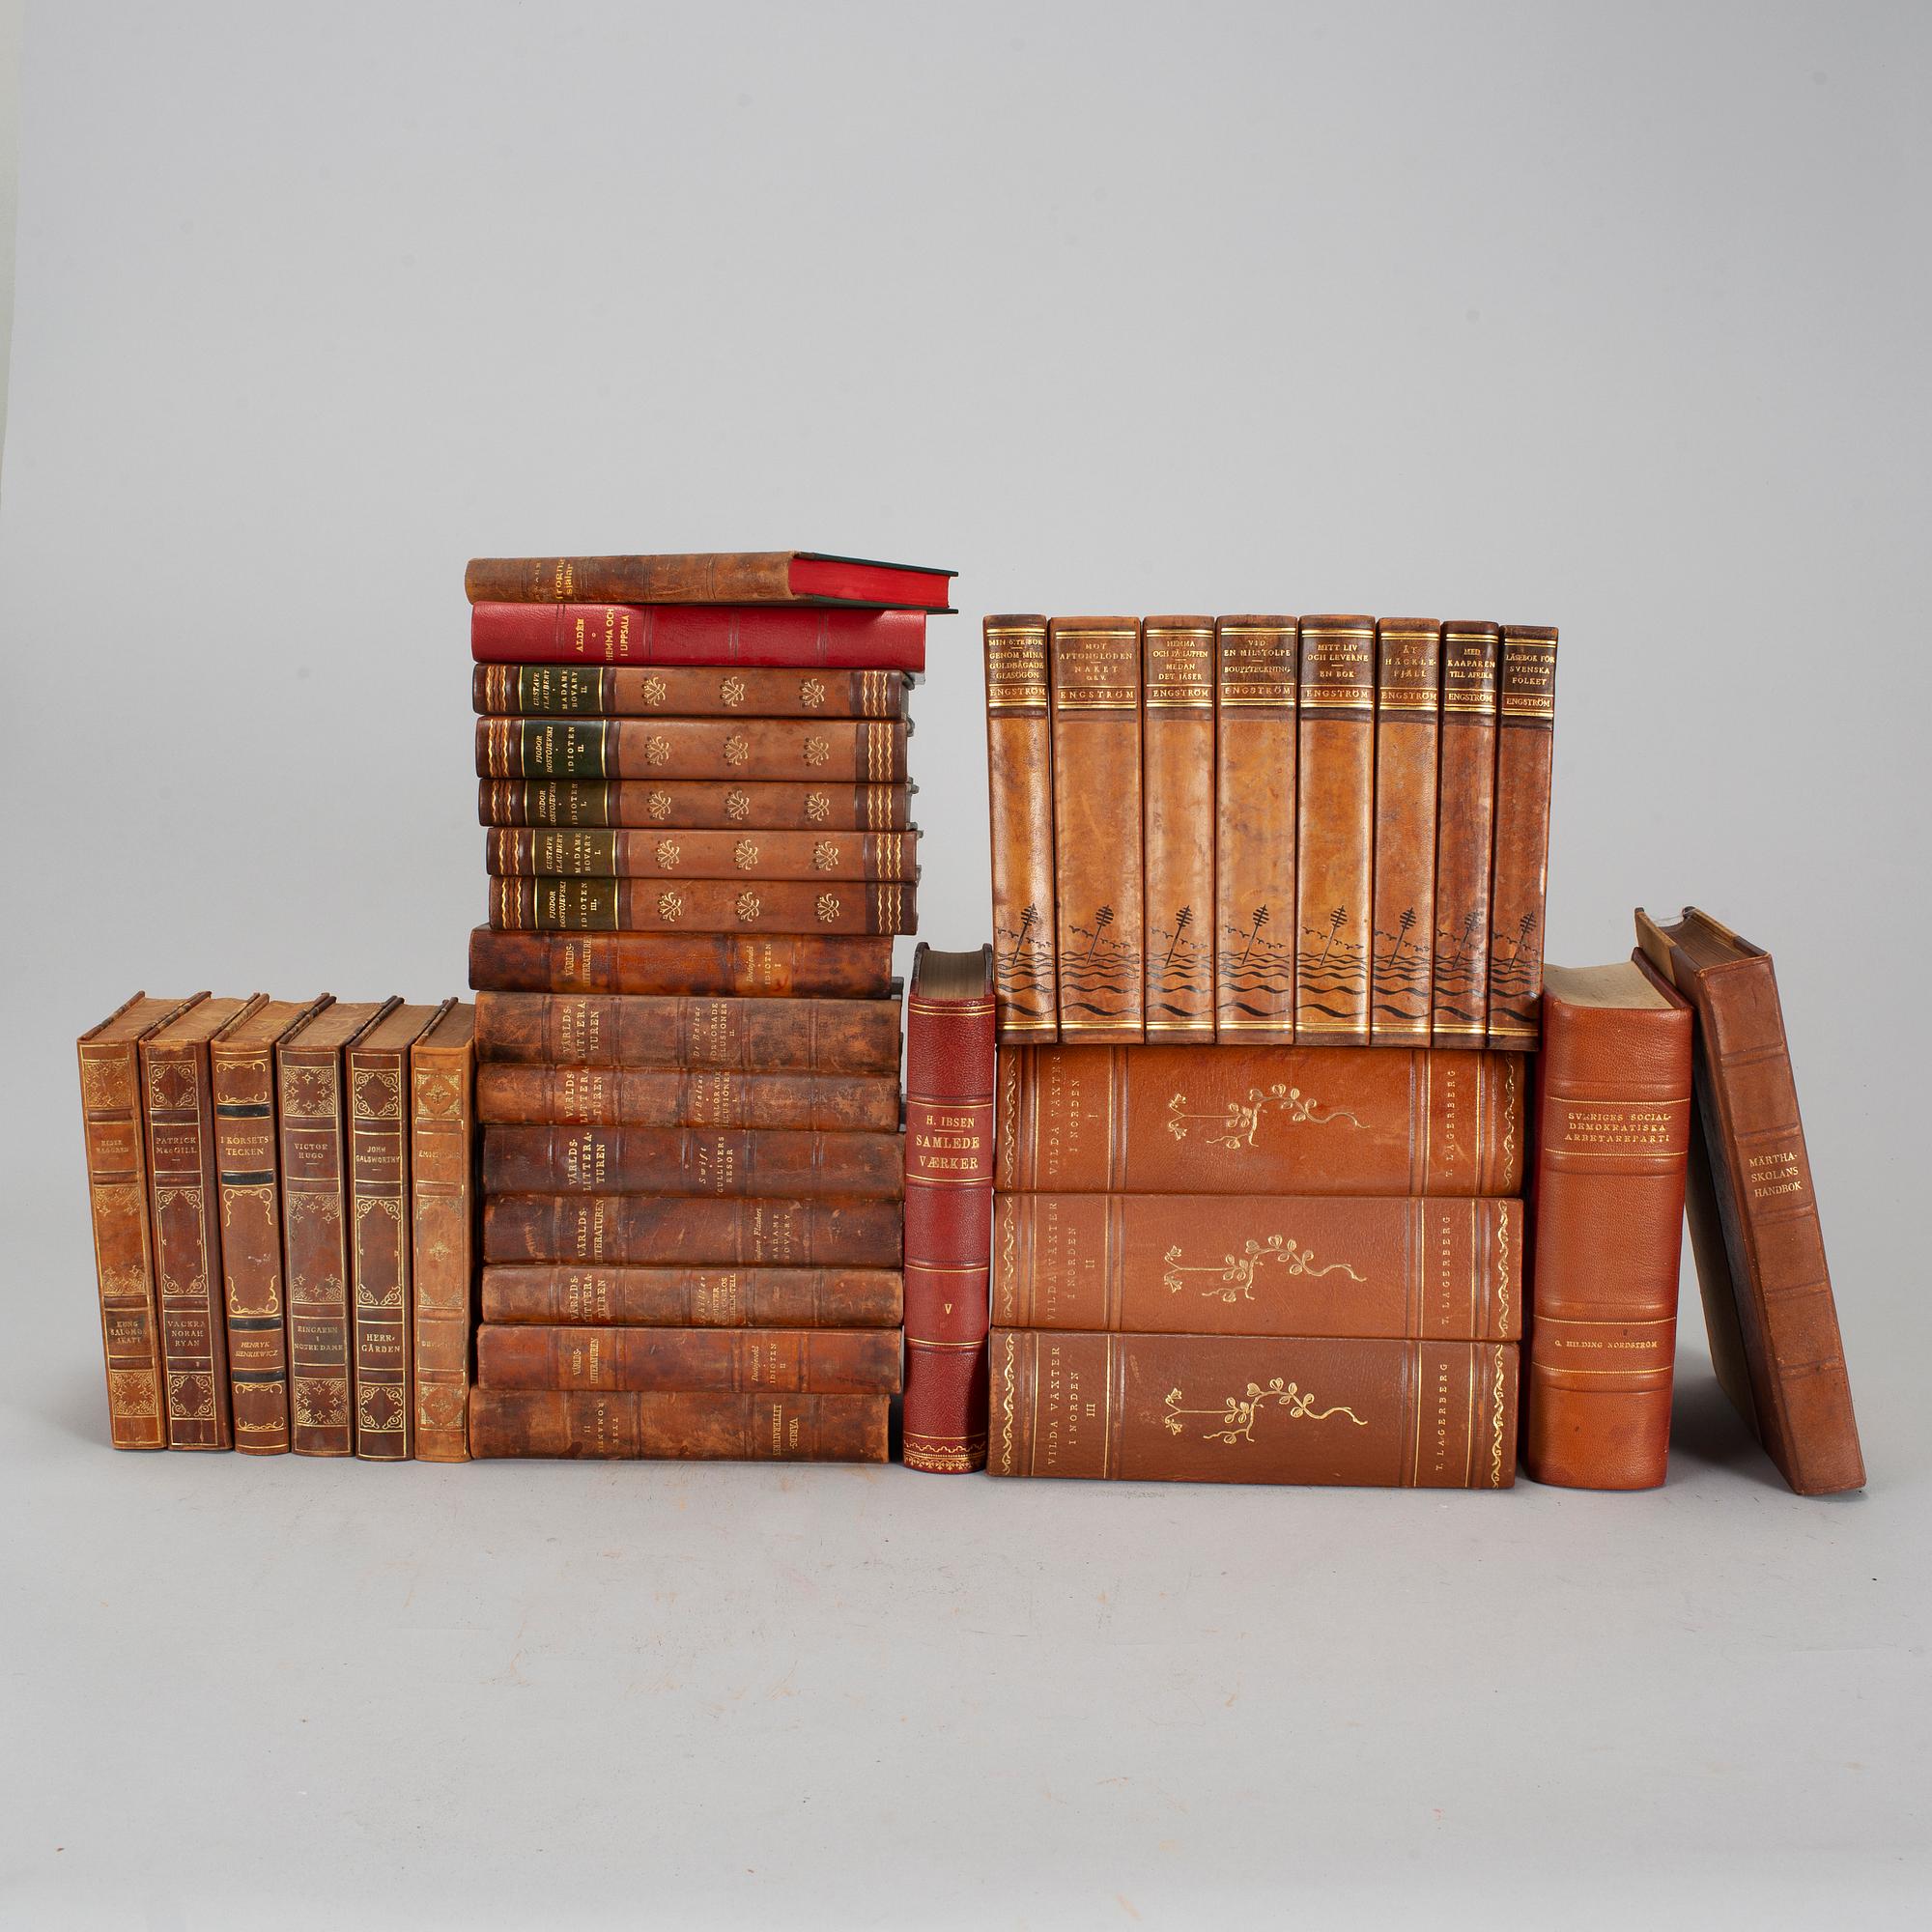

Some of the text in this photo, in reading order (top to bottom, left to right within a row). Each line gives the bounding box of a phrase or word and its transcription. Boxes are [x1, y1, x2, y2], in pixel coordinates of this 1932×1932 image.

[620, 614, 629, 650] UPPSALA
[1510, 666, 1549, 674] SVENSKA
[989, 687, 1045, 696] ENGSTRÖM
[1060, 690, 1134, 698] ENGSTRÖM
[1153, 689, 1208, 697] ENGSTRÖM
[1225, 686, 1291, 695] ENGSTRÖM
[1306, 690, 1368, 698] ENGSTRÖM
[1381, 692, 1436, 700] ENGSTRÖM
[1449, 694, 1492, 702] ENGSTRÖM
[1507, 697, 1549, 707] ENGSTRÖM
[590, 1010, 599, 1050] TUREN
[593, 1076, 602, 1115] TUREN
[1070, 1080, 1080, 1138] NORDEN
[1446, 1070, 1455, 1161] LAGERBERG
[926, 1116, 975, 1128] H. IBSEN
[1569, 1122, 1665, 1131] DEMOKRATISKA
[917, 1135, 980, 1149] SAMLEDE
[1565, 1134, 1669, 1143] ARBETAREPARTI
[225, 1148, 264, 1156] TECKEN
[1050, 1127, 1060, 1175] VILDA
[355, 1154, 400, 1163] GALSWORTHY
[596, 1144, 605, 1183] TUREN
[920, 1155, 978, 1169] VÆRKER
[698, 1148, 708, 1184] Swift
[1750, 1167, 1799, 1182] SKOLANS
[1754, 1181, 1803, 1198] HANDBOK
[1047, 1202, 1058, 1321] VILDA VÄXTER
[1066, 1228, 1076, 1287] NORDEN
[1086, 1260, 1094, 1268] II
[597, 1280, 606, 1318] TUREN
[945, 1304, 952, 1314] V
[361, 1344, 400, 1352] GÅRDEN
[1048, 1347, 1060, 1464] VILDA VÄXTER
[1069, 1372, 1078, 1432] NORDEN
[1086, 1403, 1095, 1417] III
[1437, 1364, 1447, 1456] LAGERBERG
